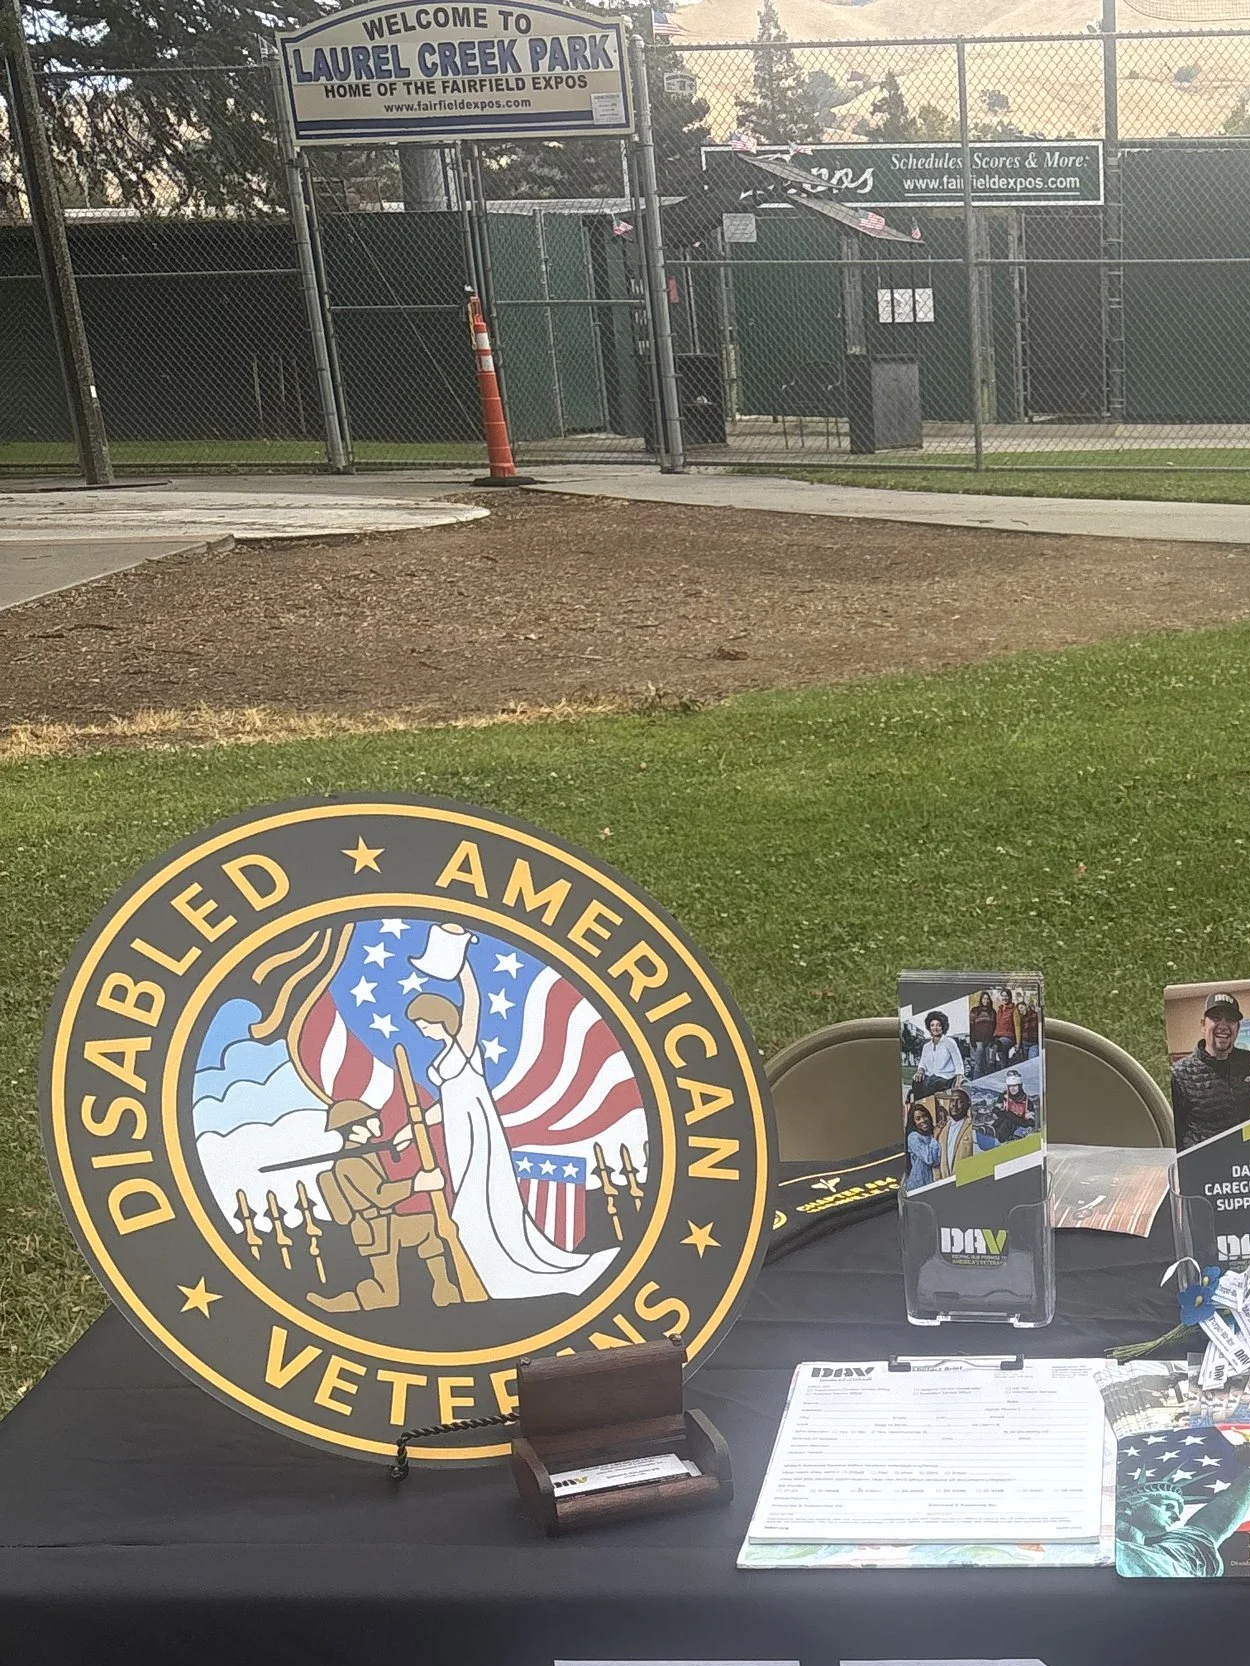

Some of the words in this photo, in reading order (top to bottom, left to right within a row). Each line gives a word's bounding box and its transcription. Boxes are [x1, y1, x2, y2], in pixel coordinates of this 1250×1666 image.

[362, 7, 488, 41] WELCOME
[498, 10, 531, 34] TO
[293, 44, 411, 83] LAUREL
[417, 38, 522, 78] CREEK
[528, 34, 614, 73] PARK
[324, 84, 372, 99] HOME
[377, 82, 398, 97] OF
[403, 80, 436, 96] THE
[442, 77, 526, 94] FAIRFIELD
[532, 75, 588, 91] EXPOS
[384, 98, 531, 113] www.fairfieldexpos.com
[890, 151, 963, 170] Schedules
[972, 151, 1021, 169] Scores
[1024, 152, 1039, 169] &
[903, 173, 1080, 192] www.faiieldexpos.com
[435, 839, 742, 1182] AMERICAN
[82, 852, 292, 1236] DISABLED
[940, 1227, 1007, 1255] DAV
[810, 1366, 876, 1378] DAV
[1214, 1364, 1225, 1381] DAV
